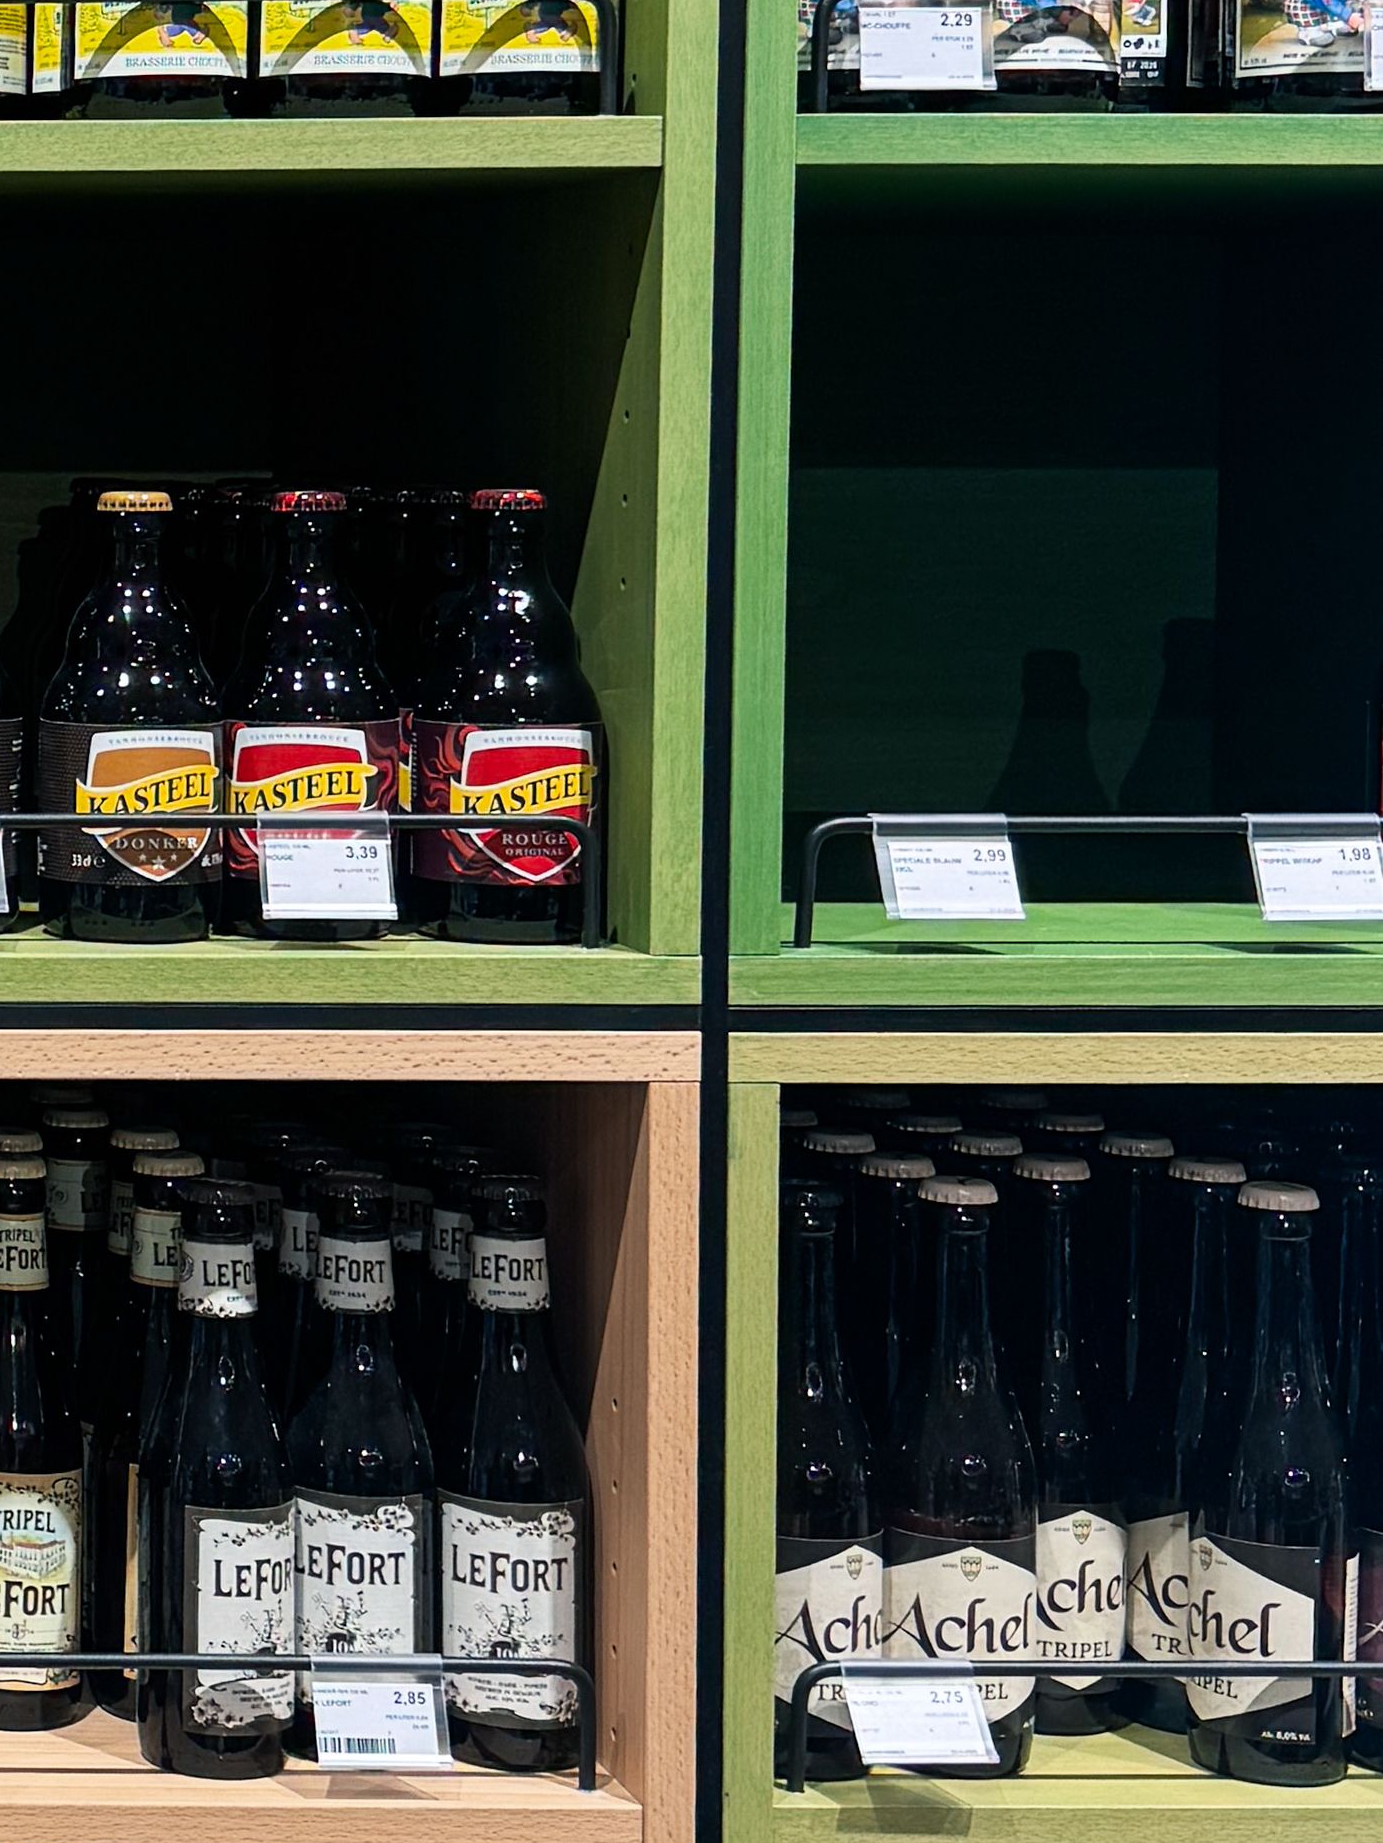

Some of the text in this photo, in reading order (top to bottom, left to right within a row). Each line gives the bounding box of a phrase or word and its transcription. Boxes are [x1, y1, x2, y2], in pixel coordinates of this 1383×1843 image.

[940, 13, 973, 28] 2,29
[125, 56, 186, 68] BRASSERIE
[314, 55, 375, 67] BRASSERIE
[88, 770, 211, 816] KASTEEL
[235, 769, 362, 815] KASTEEL
[463, 770, 590, 816] KASTEEL
[114, 835, 199, 851] DONKER
[501, 834, 568, 847] ROUGE
[344, 845, 378, 860] 3,39
[505, 848, 565, 857] ORIGINAL
[972, 848, 1007, 863] 2,99
[1338, 848, 1372, 862] 1,98
[451, 1543, 569, 1593] LEFORT
[886, 1591, 1033, 1657] Achel
[1040, 1640, 1114, 1659] TRIPEL
[393, 1691, 426, 1706] 2,85
[929, 1689, 963, 1705] 2,75
